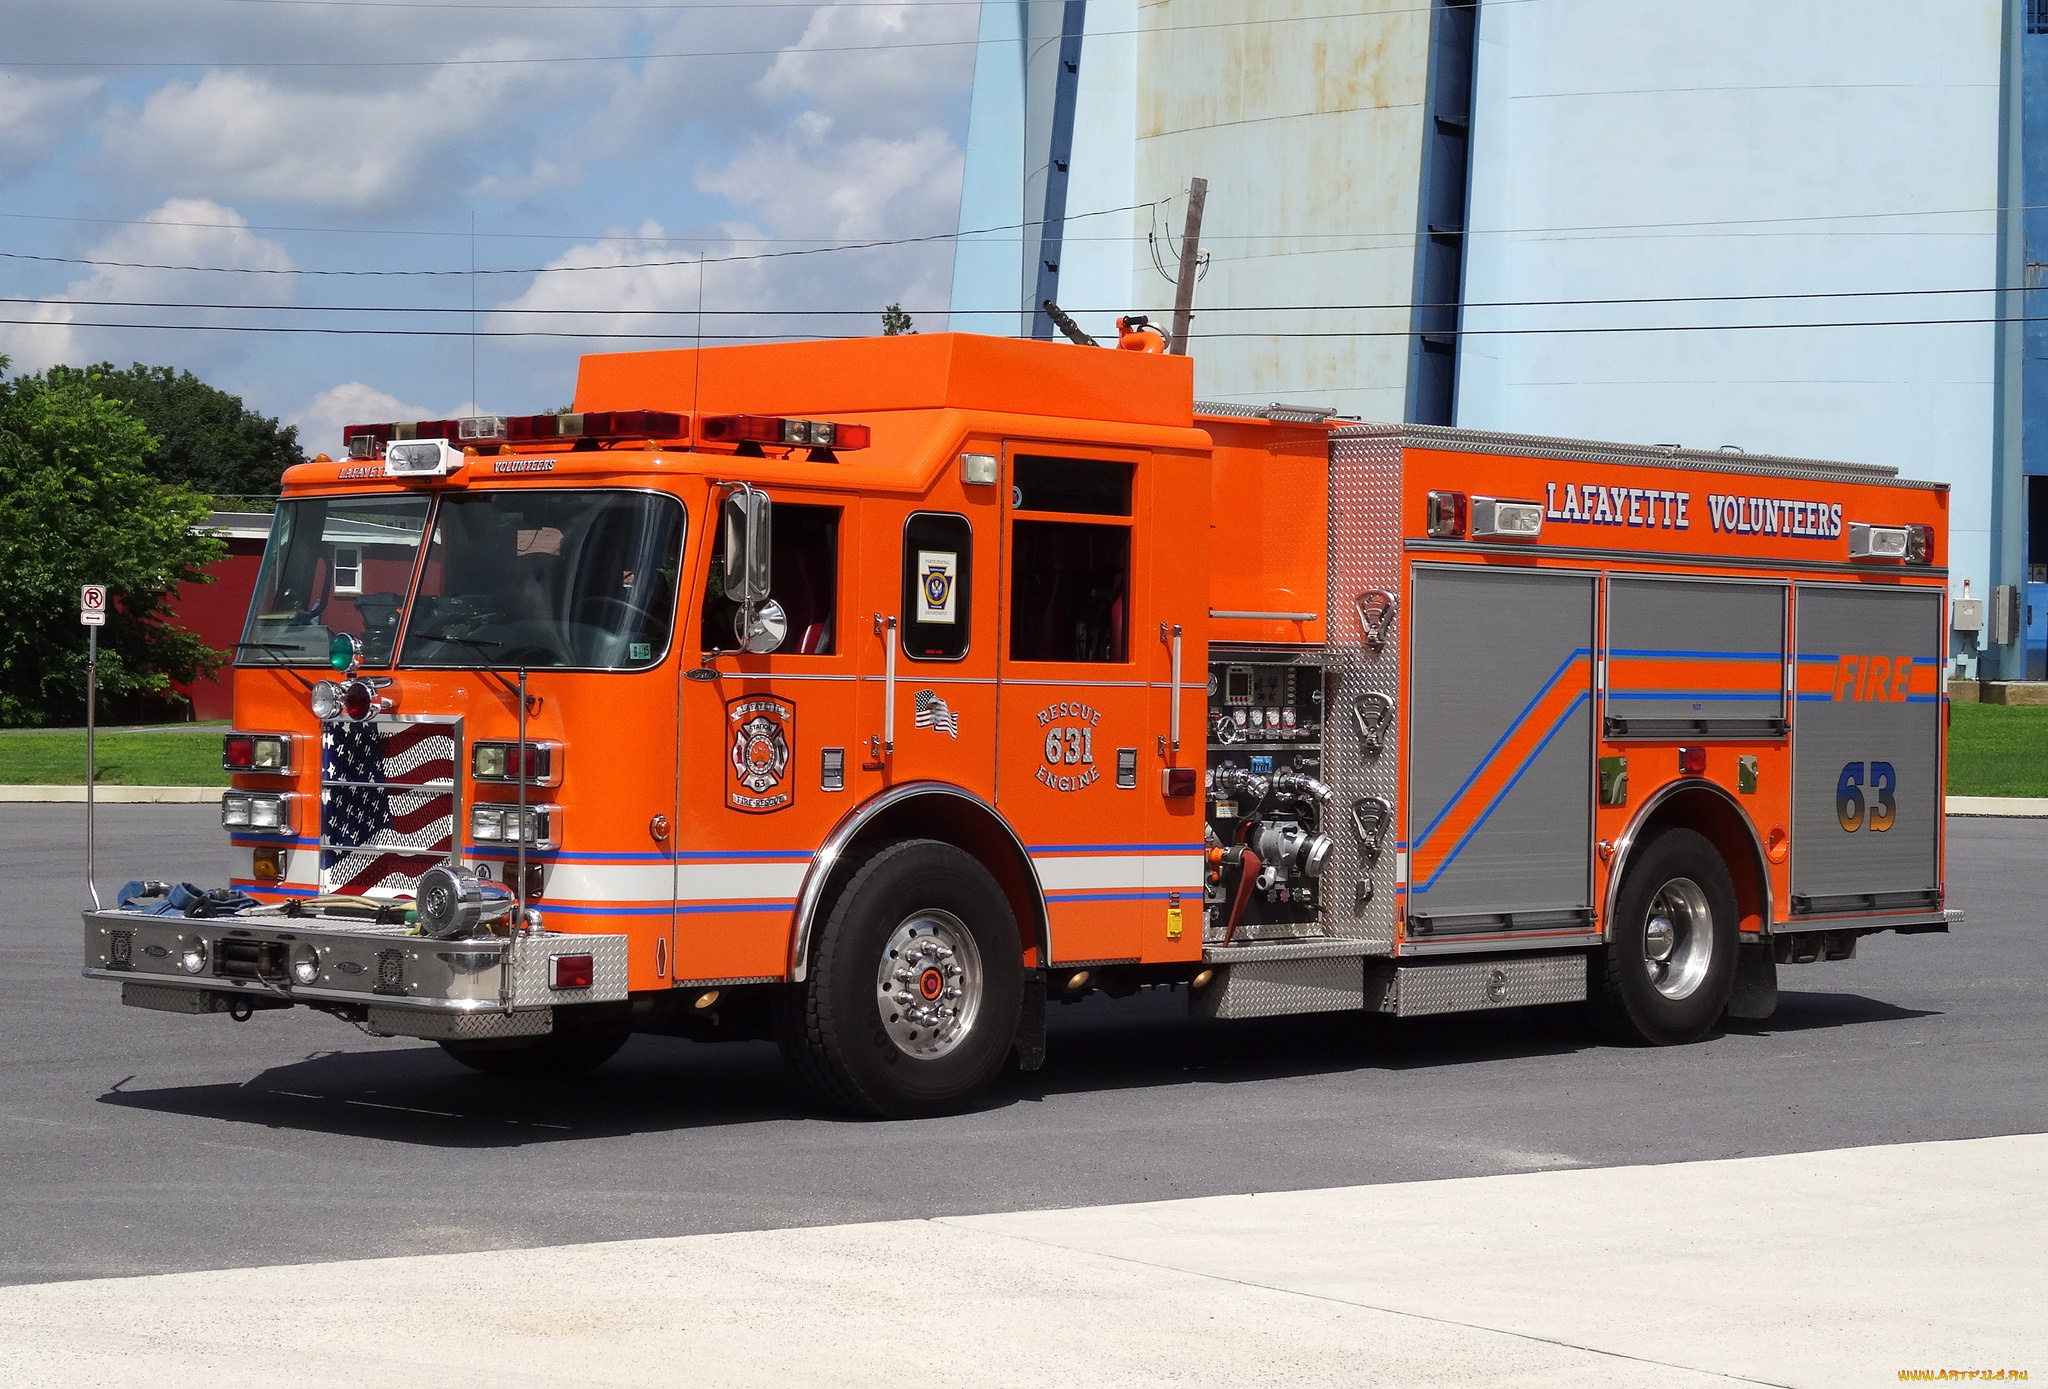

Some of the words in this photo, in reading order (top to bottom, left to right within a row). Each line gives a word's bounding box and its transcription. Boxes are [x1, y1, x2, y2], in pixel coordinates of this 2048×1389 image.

[338, 467, 392, 479] LAFAYETT
[494, 460, 556, 473] VOLUNTEERS
[1546, 481, 1690, 528] LAFAYETTE
[1708, 494, 1842, 540] VOLUNTEERS
[1833, 655, 1912, 702] FIRE
[740, 702, 783, 713] LAFAYETTE
[1036, 701, 1102, 728] RESCUE
[749, 723, 773, 733] STATION
[1045, 726, 1093, 765] 631
[754, 779, 766, 789] 63
[1034, 764, 1100, 793] ENGINE
[736, 795, 784, 807] FIRE-RESCUE
[1836, 761, 1897, 833] 63
